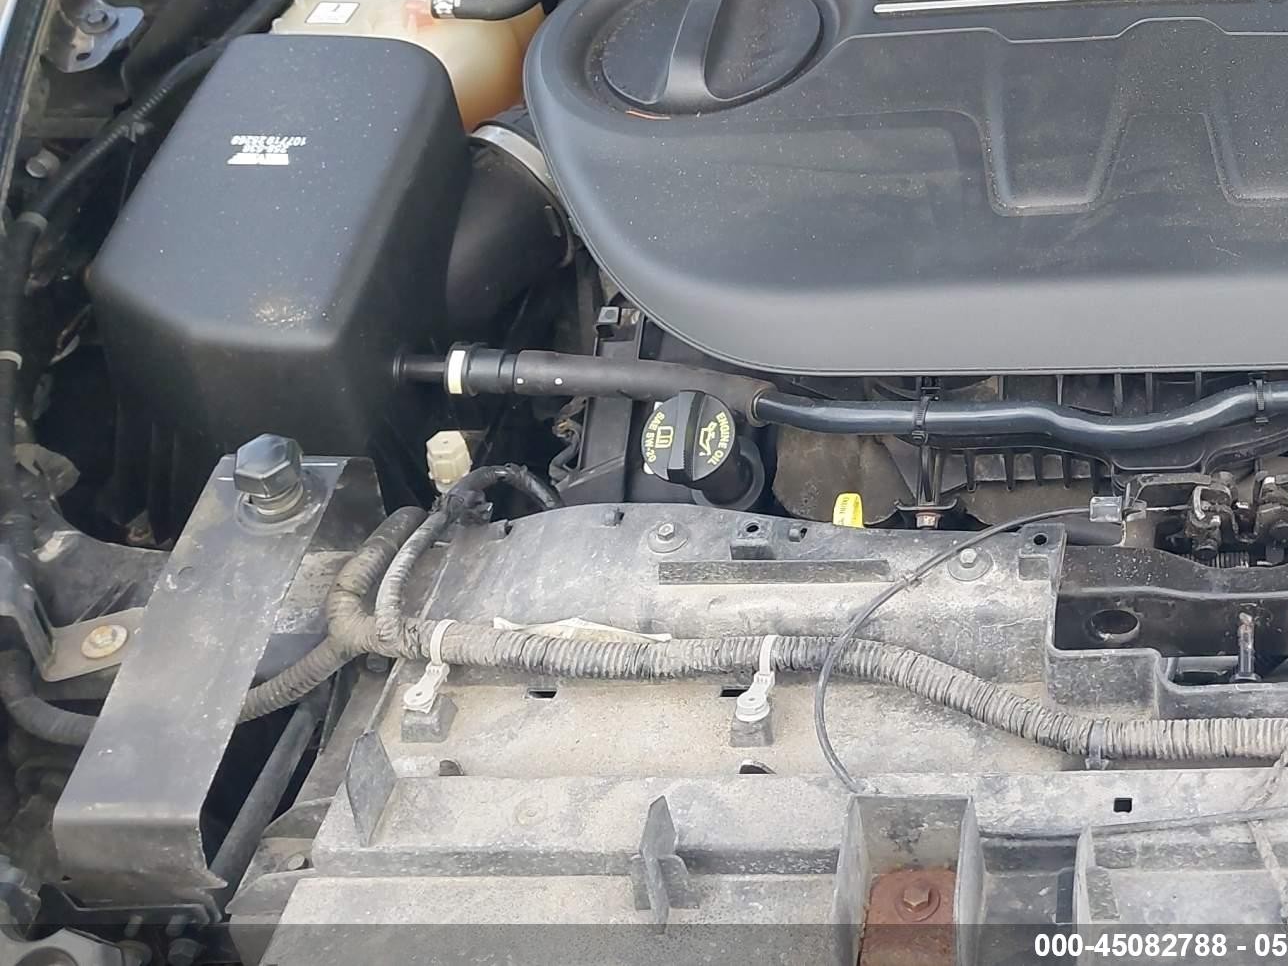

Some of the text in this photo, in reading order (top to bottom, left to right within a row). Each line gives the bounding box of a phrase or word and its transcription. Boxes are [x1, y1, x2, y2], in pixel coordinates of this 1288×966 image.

[645, 411, 665, 463] SAE 5W-20
[707, 411, 730, 466] ENGINE OIL
